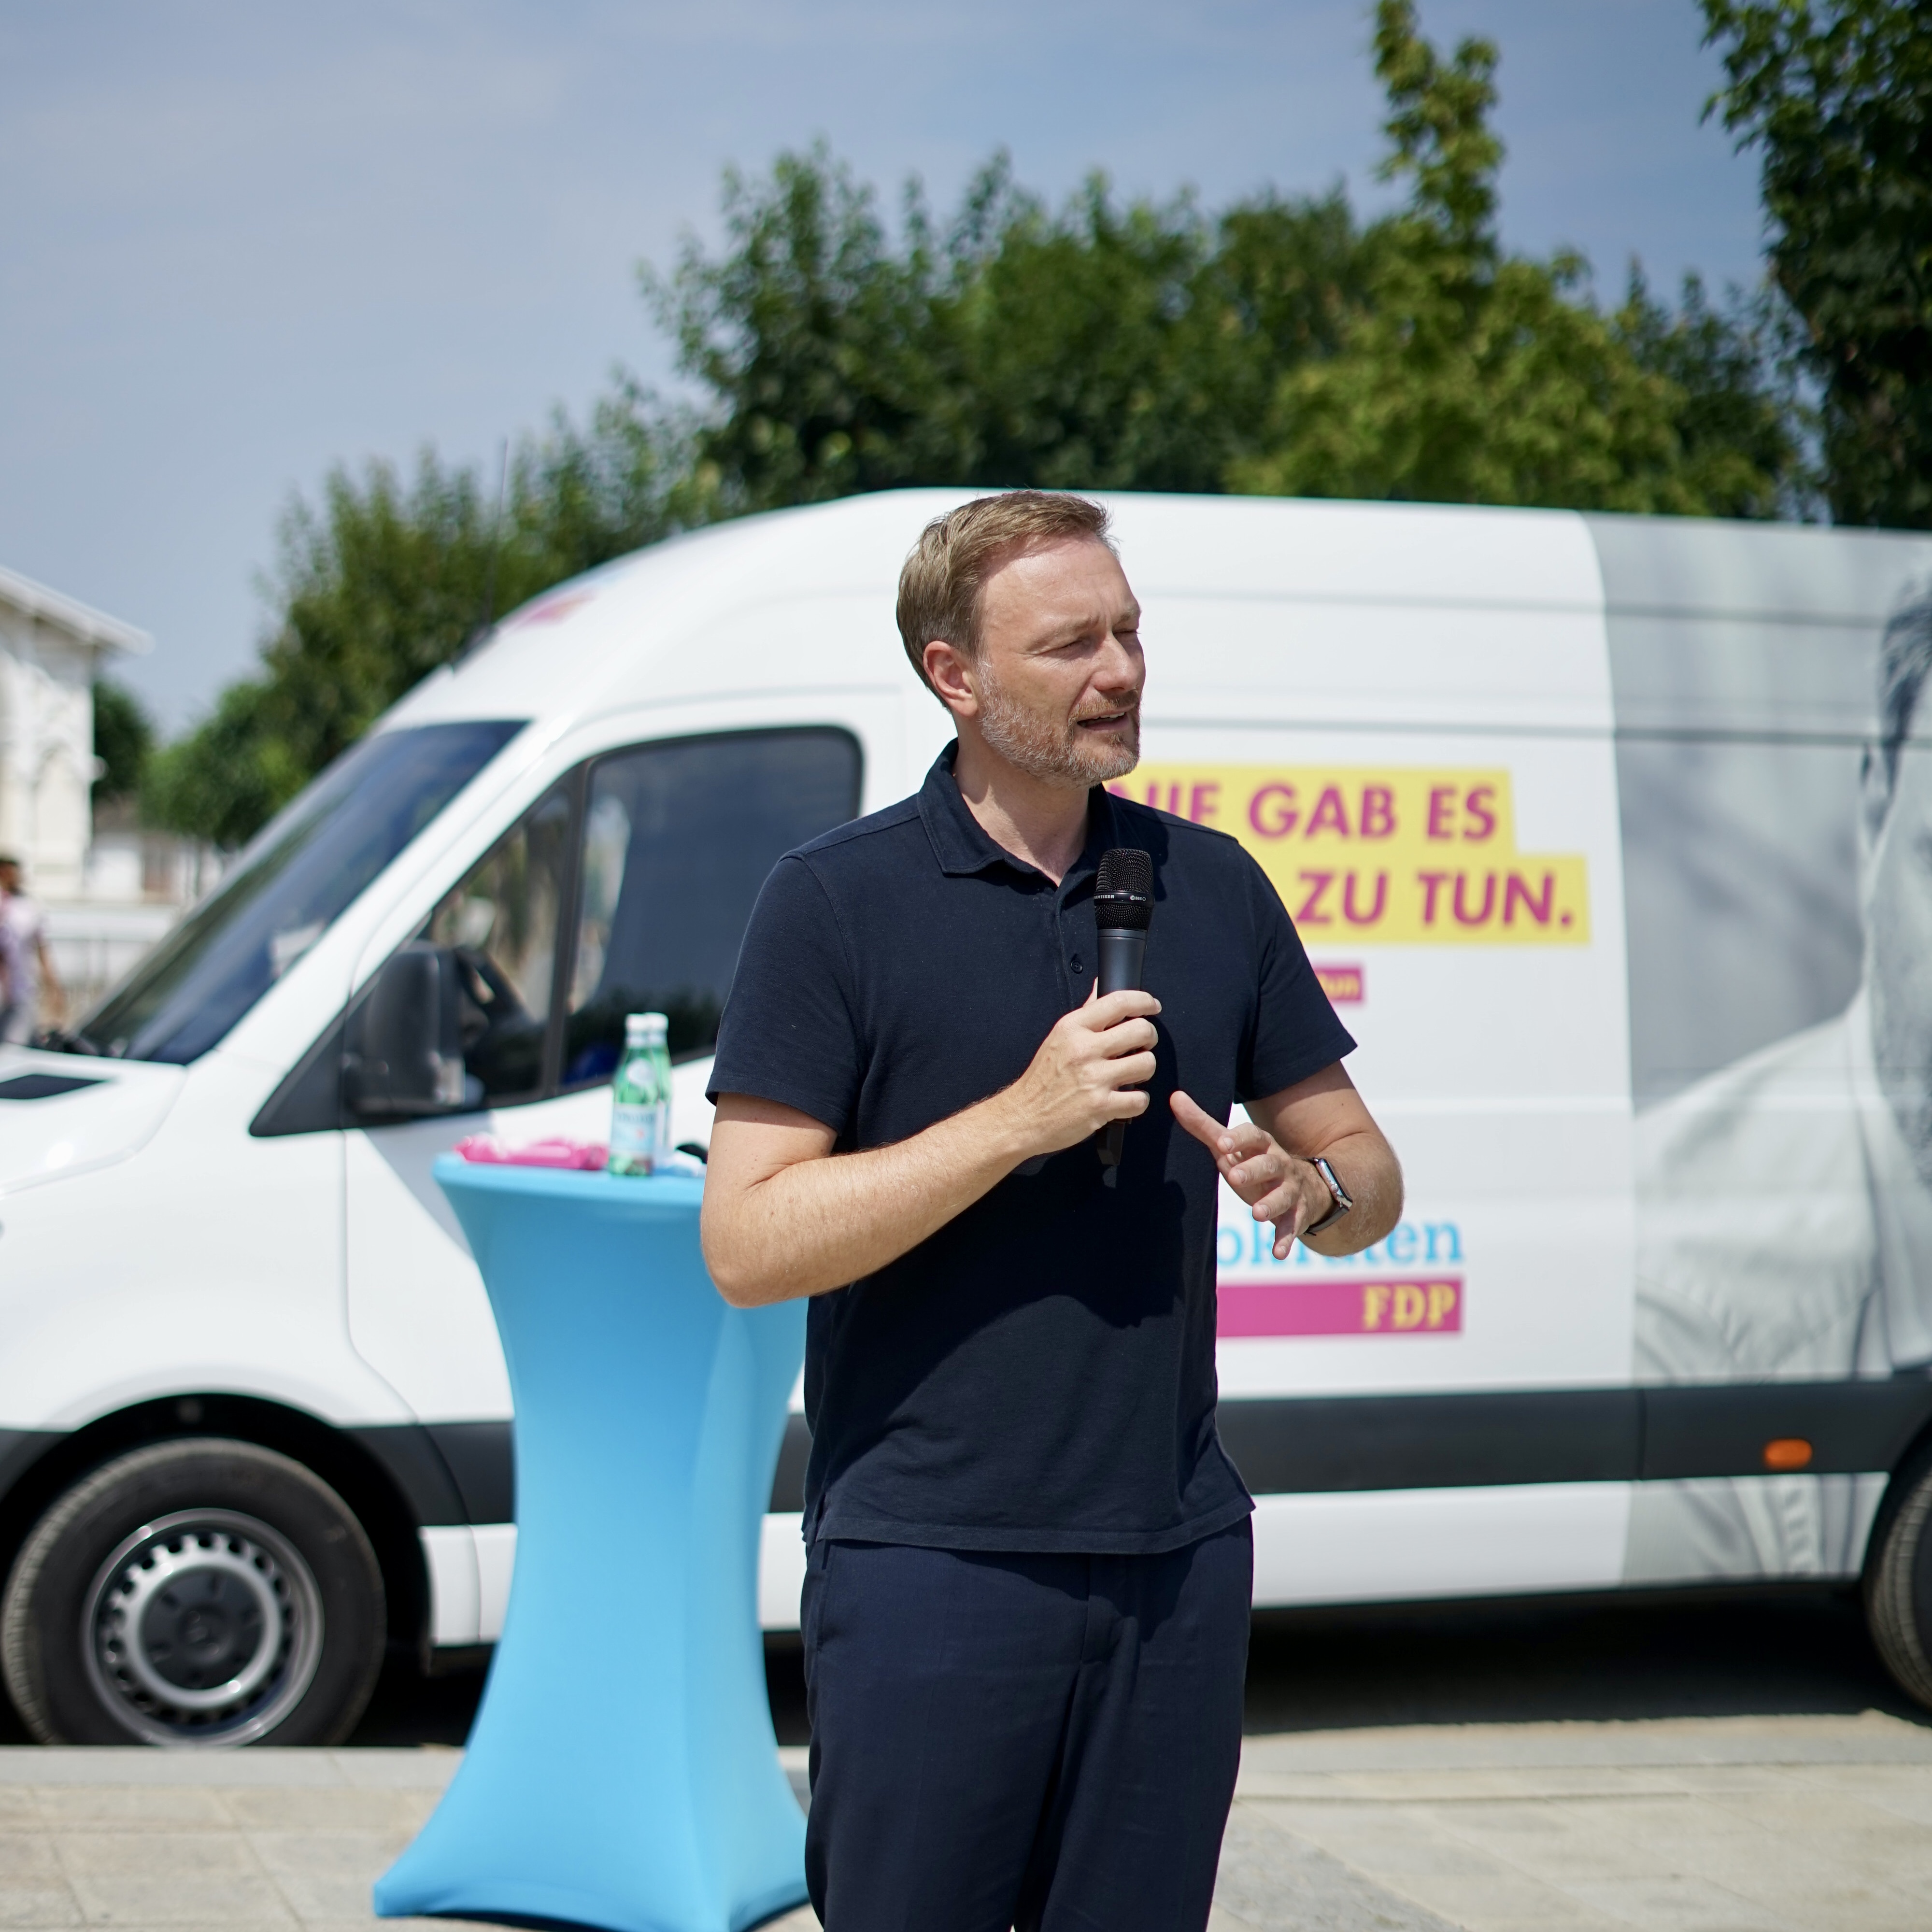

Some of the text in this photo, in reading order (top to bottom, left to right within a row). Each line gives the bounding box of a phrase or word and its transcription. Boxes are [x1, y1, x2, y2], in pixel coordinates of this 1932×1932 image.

[1248, 783, 1396, 839] GAB
[1426, 783, 1497, 839] ES
[1295, 870, 1571, 924] ZU TUN.
[1364, 1284, 1456, 1330] FDP
